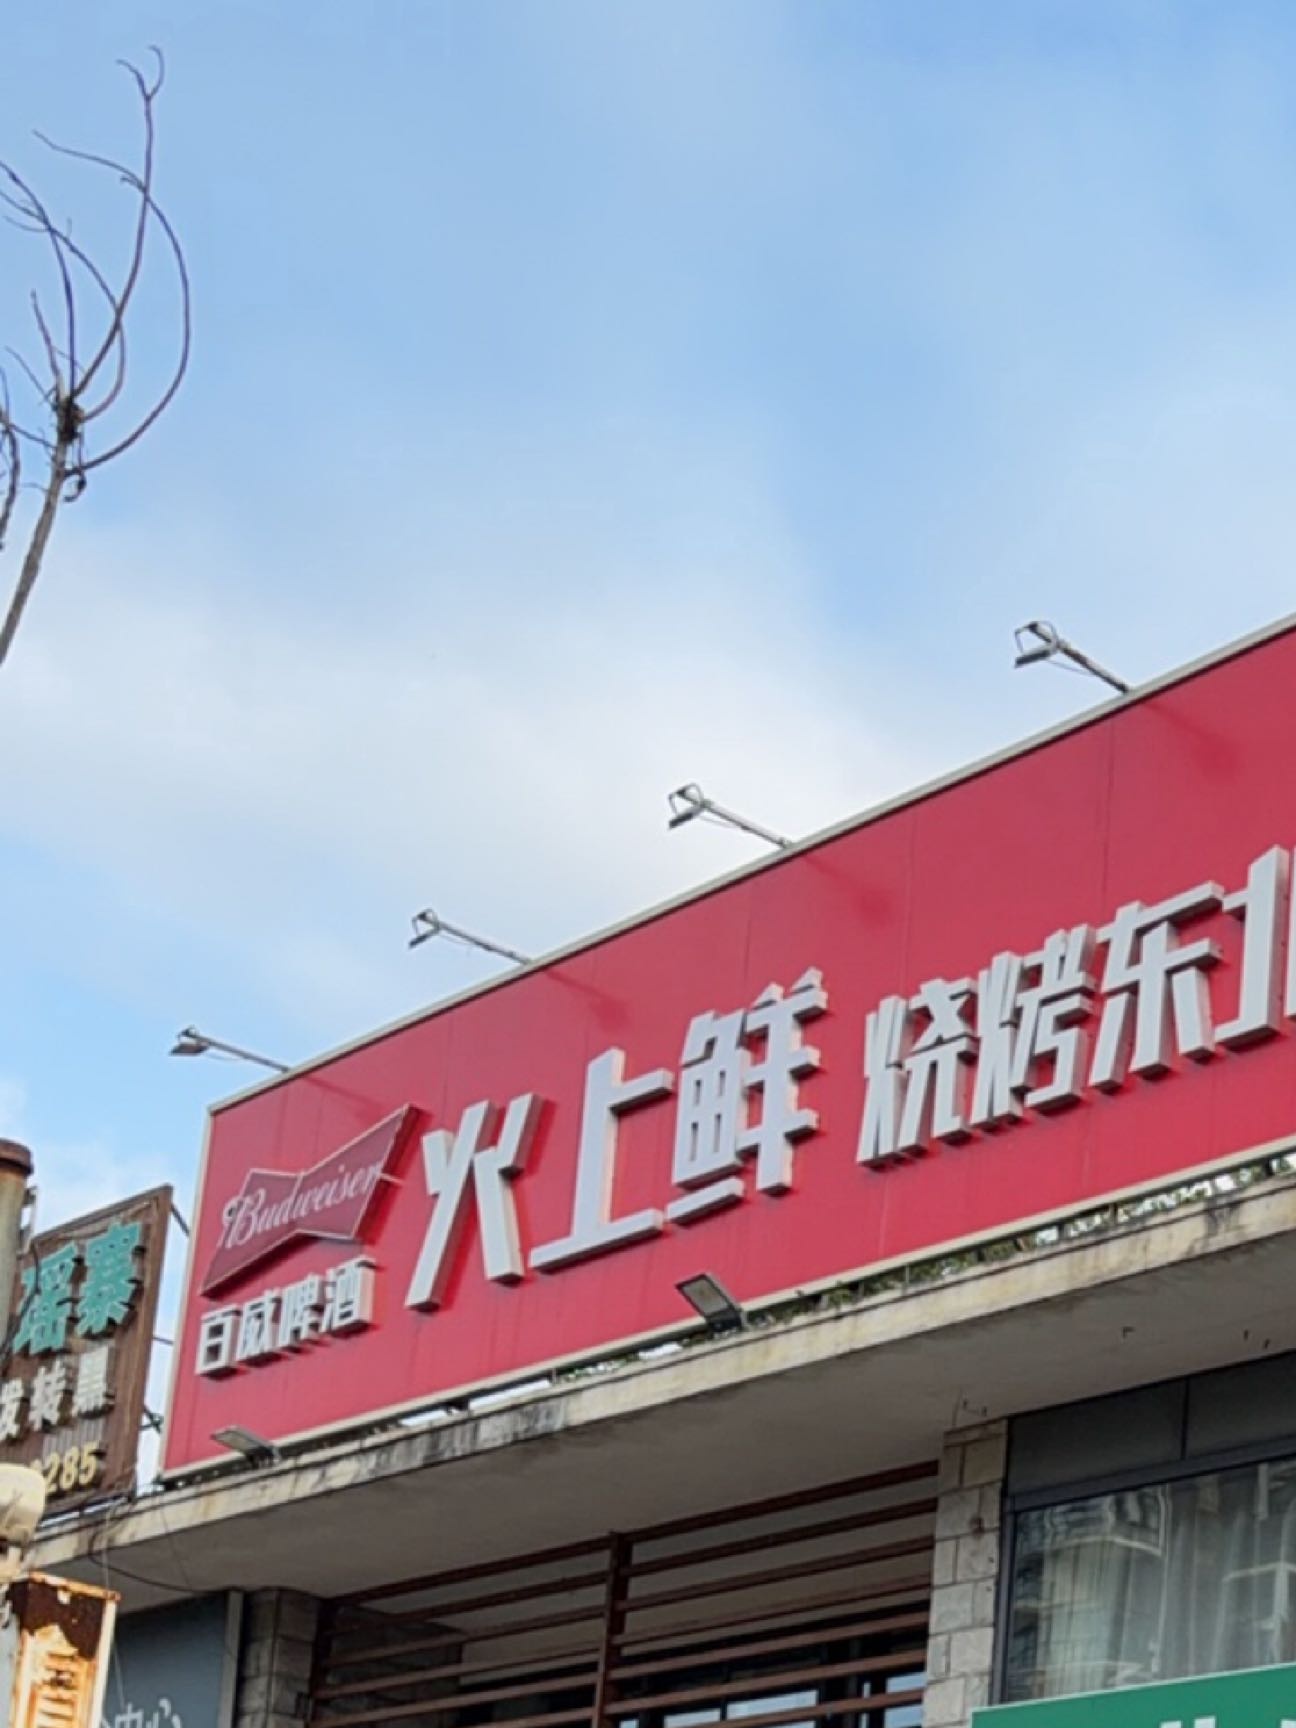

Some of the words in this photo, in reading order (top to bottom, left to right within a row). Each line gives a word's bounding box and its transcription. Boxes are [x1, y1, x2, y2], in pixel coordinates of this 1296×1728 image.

[403, 967, 830, 1311] 火上鲜
[216, 1162, 400, 1248] Budweiser
[195, 1256, 376, 1377] 百威啤酒
